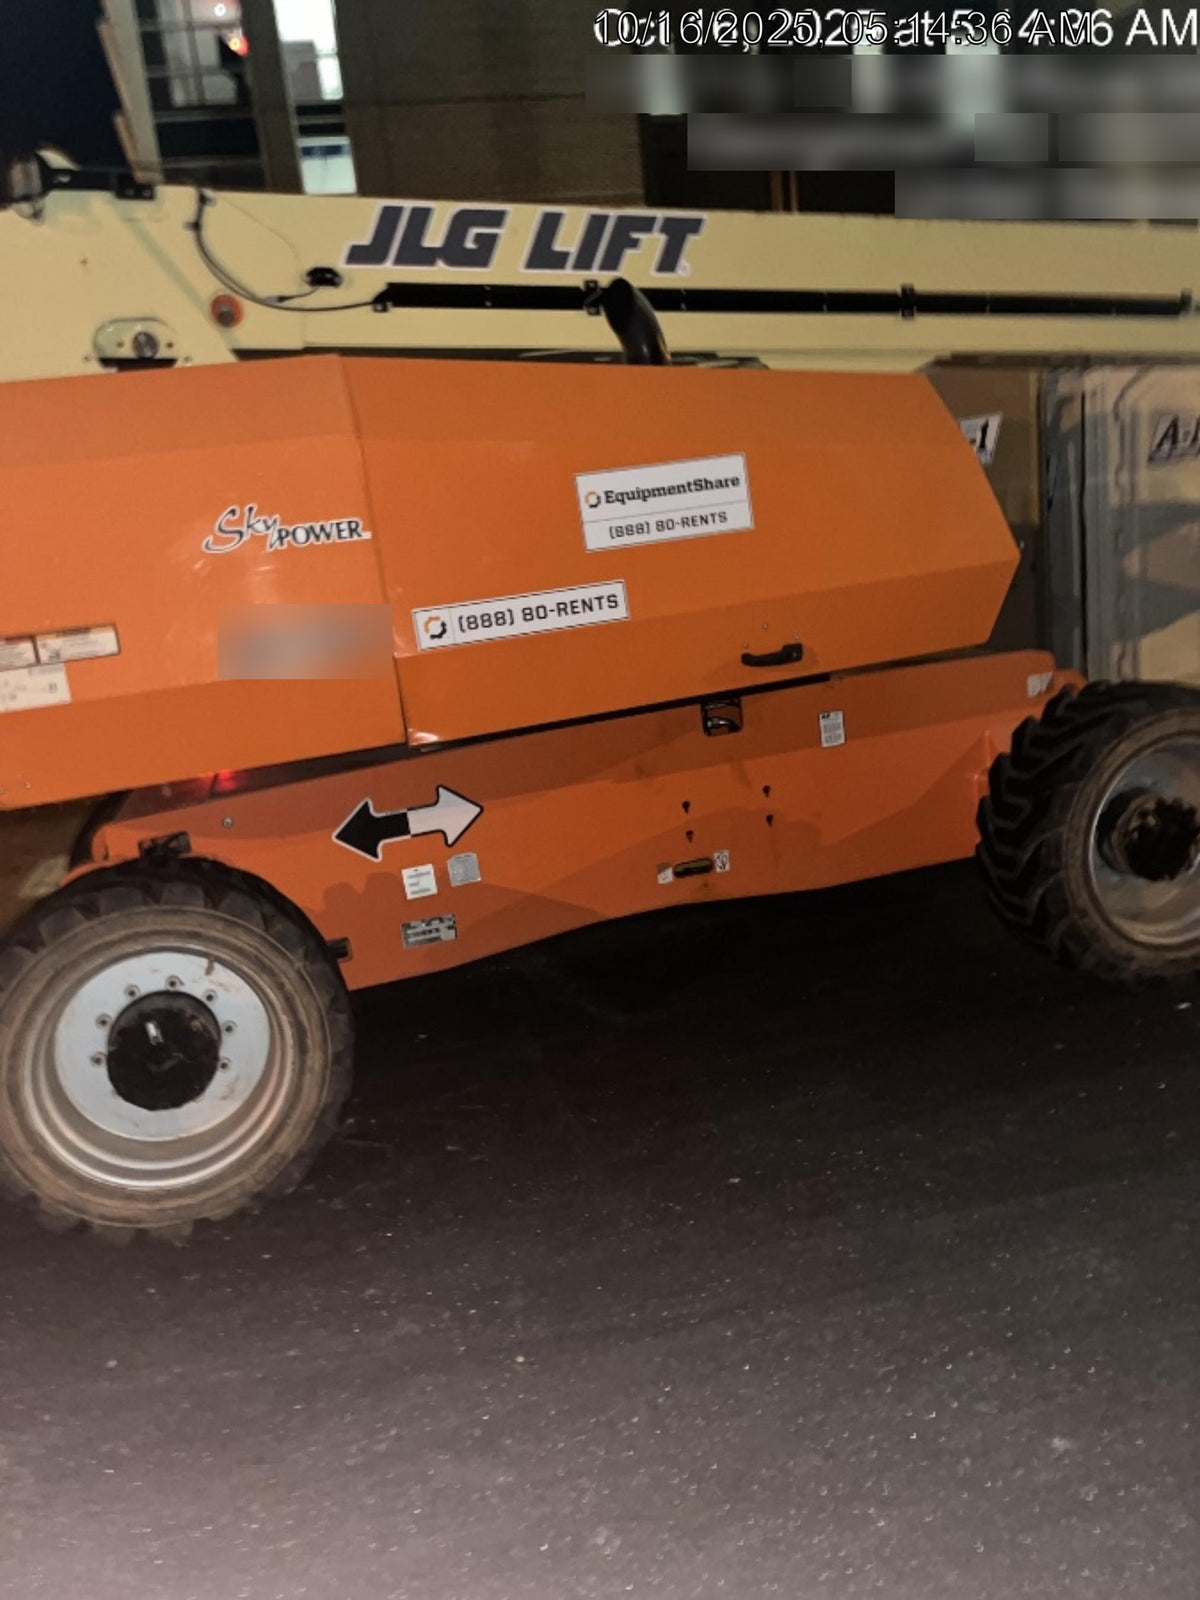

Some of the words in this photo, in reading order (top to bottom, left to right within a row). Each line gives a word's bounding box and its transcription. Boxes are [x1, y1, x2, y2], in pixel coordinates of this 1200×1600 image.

[343, 204, 510, 269] JLG
[521, 209, 706, 275] LIFT
[603, 475, 741, 506] EquipmentShare
[608, 520, 651, 540] (888)
[655, 511, 728, 533] 80-RENTS
[457, 607, 515, 634] (888)
[522, 593, 619, 623] 80-RENTS
